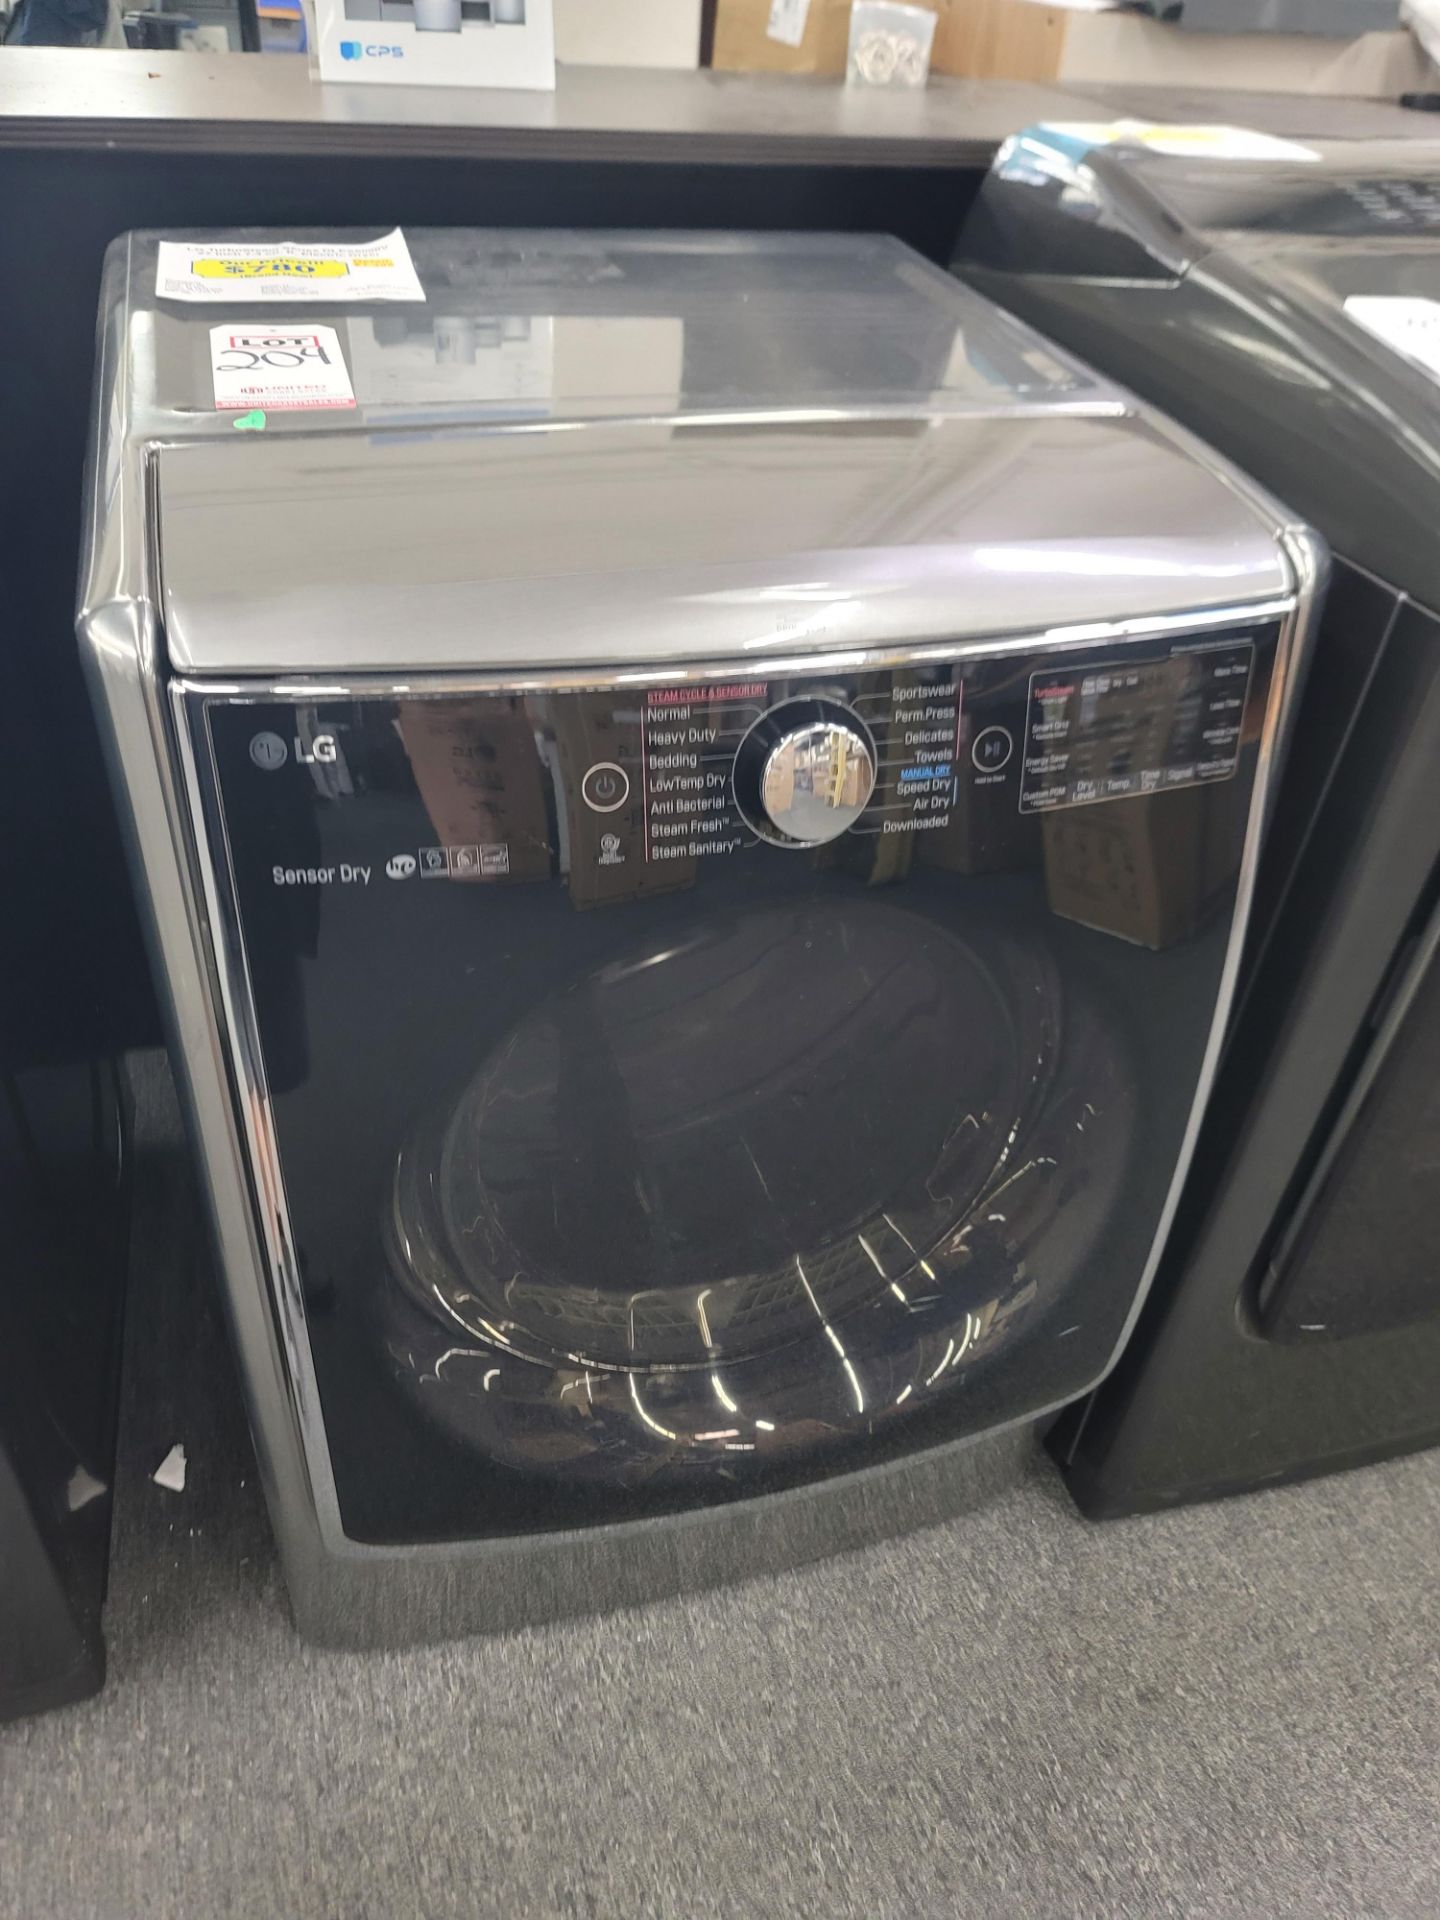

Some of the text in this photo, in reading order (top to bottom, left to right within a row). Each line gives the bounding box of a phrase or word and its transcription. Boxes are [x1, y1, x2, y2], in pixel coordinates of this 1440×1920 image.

[365, 45, 404, 57] CPS
[241, 337, 310, 347] LOT
[647, 689, 679, 704] STEAM
[680, 687, 707, 702] CYCLE
[716, 684, 750, 699] SENSOR
[751, 682, 768, 696] DRY
[892, 684, 956, 702] Sportswear
[647, 704, 691, 723] Normal
[648, 727, 717, 747] Heavy Duty
[905, 728, 954, 746] Delicates
[294, 734, 337, 764] LG
[915, 748, 953, 763] Towels
[649, 752, 698, 771] Bedding
[706, 773, 726, 790] Dry
[901, 764, 951, 782] MANUAL DRY
[896, 777, 951, 797] Speed Dry
[1077, 779, 1094, 792] Dry
[913, 795, 950, 812] Air Dry
[1072, 790, 1096, 802] Level
[650, 796, 726, 817] Anti Bacterial
[651, 823, 689, 839] Steam
[883, 814, 949, 835] Downloaded
[652, 844, 688, 861] Steam
[272, 865, 335, 886] Sensor
[340, 862, 371, 885] Dry
